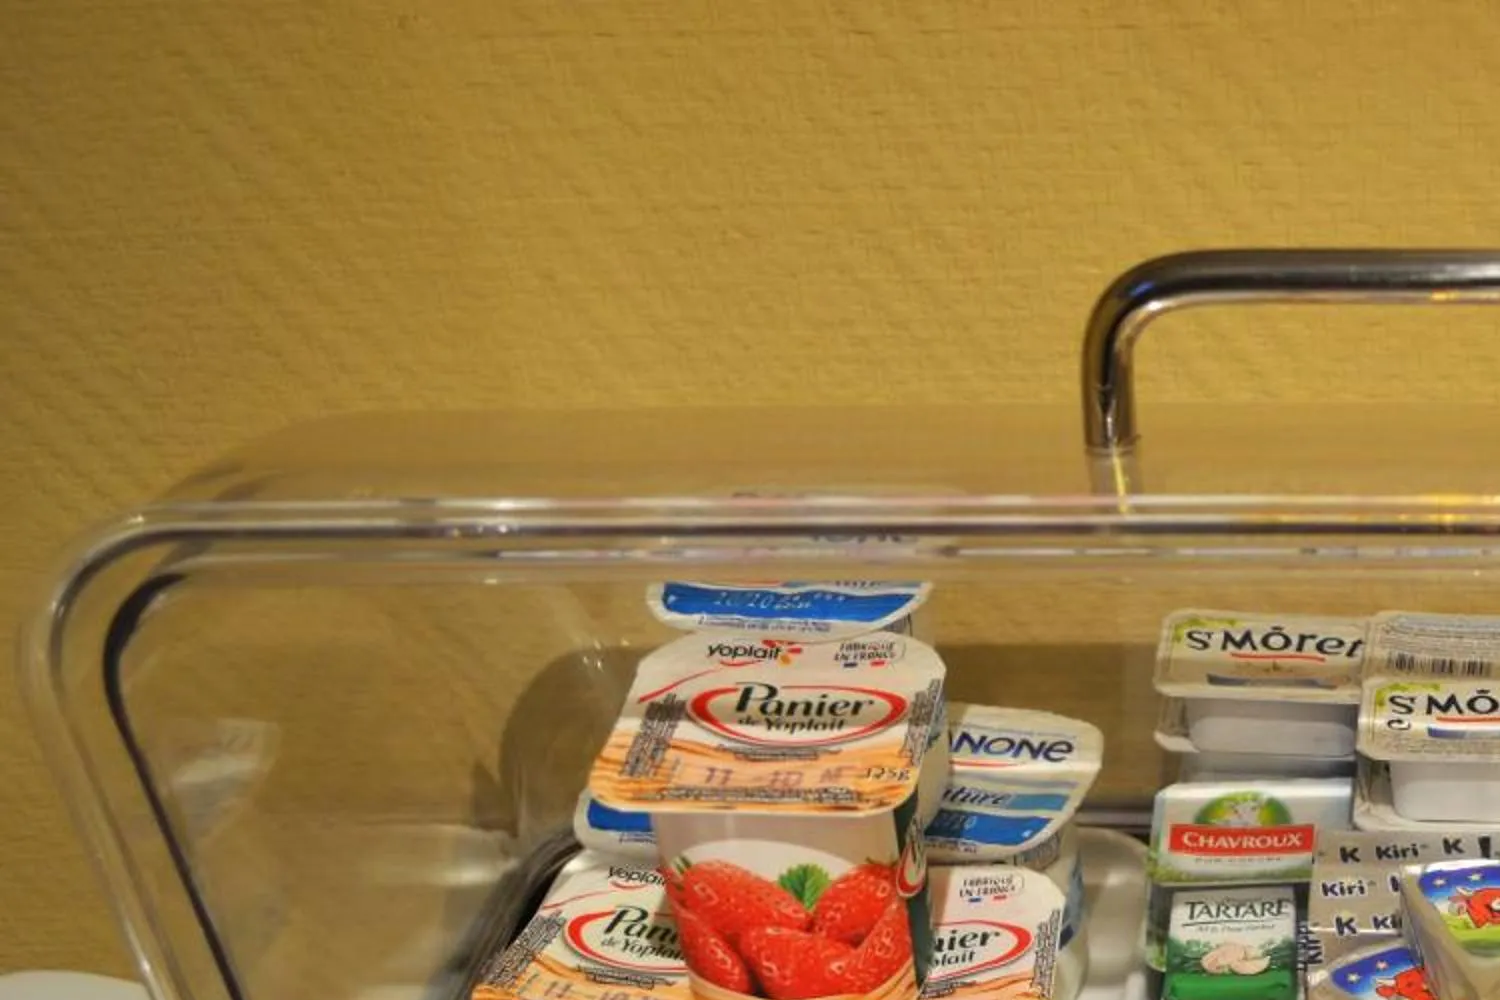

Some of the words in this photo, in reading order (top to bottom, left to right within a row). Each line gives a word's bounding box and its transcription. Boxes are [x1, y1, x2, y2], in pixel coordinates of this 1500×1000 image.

[735, 682, 875, 719] Panier
[1182, 831, 1304, 848] CHAVROUX
[1375, 843, 1420, 860] Kiri
[1322, 880, 1366, 897] Kiri
[604, 904, 679, 944] Pani
